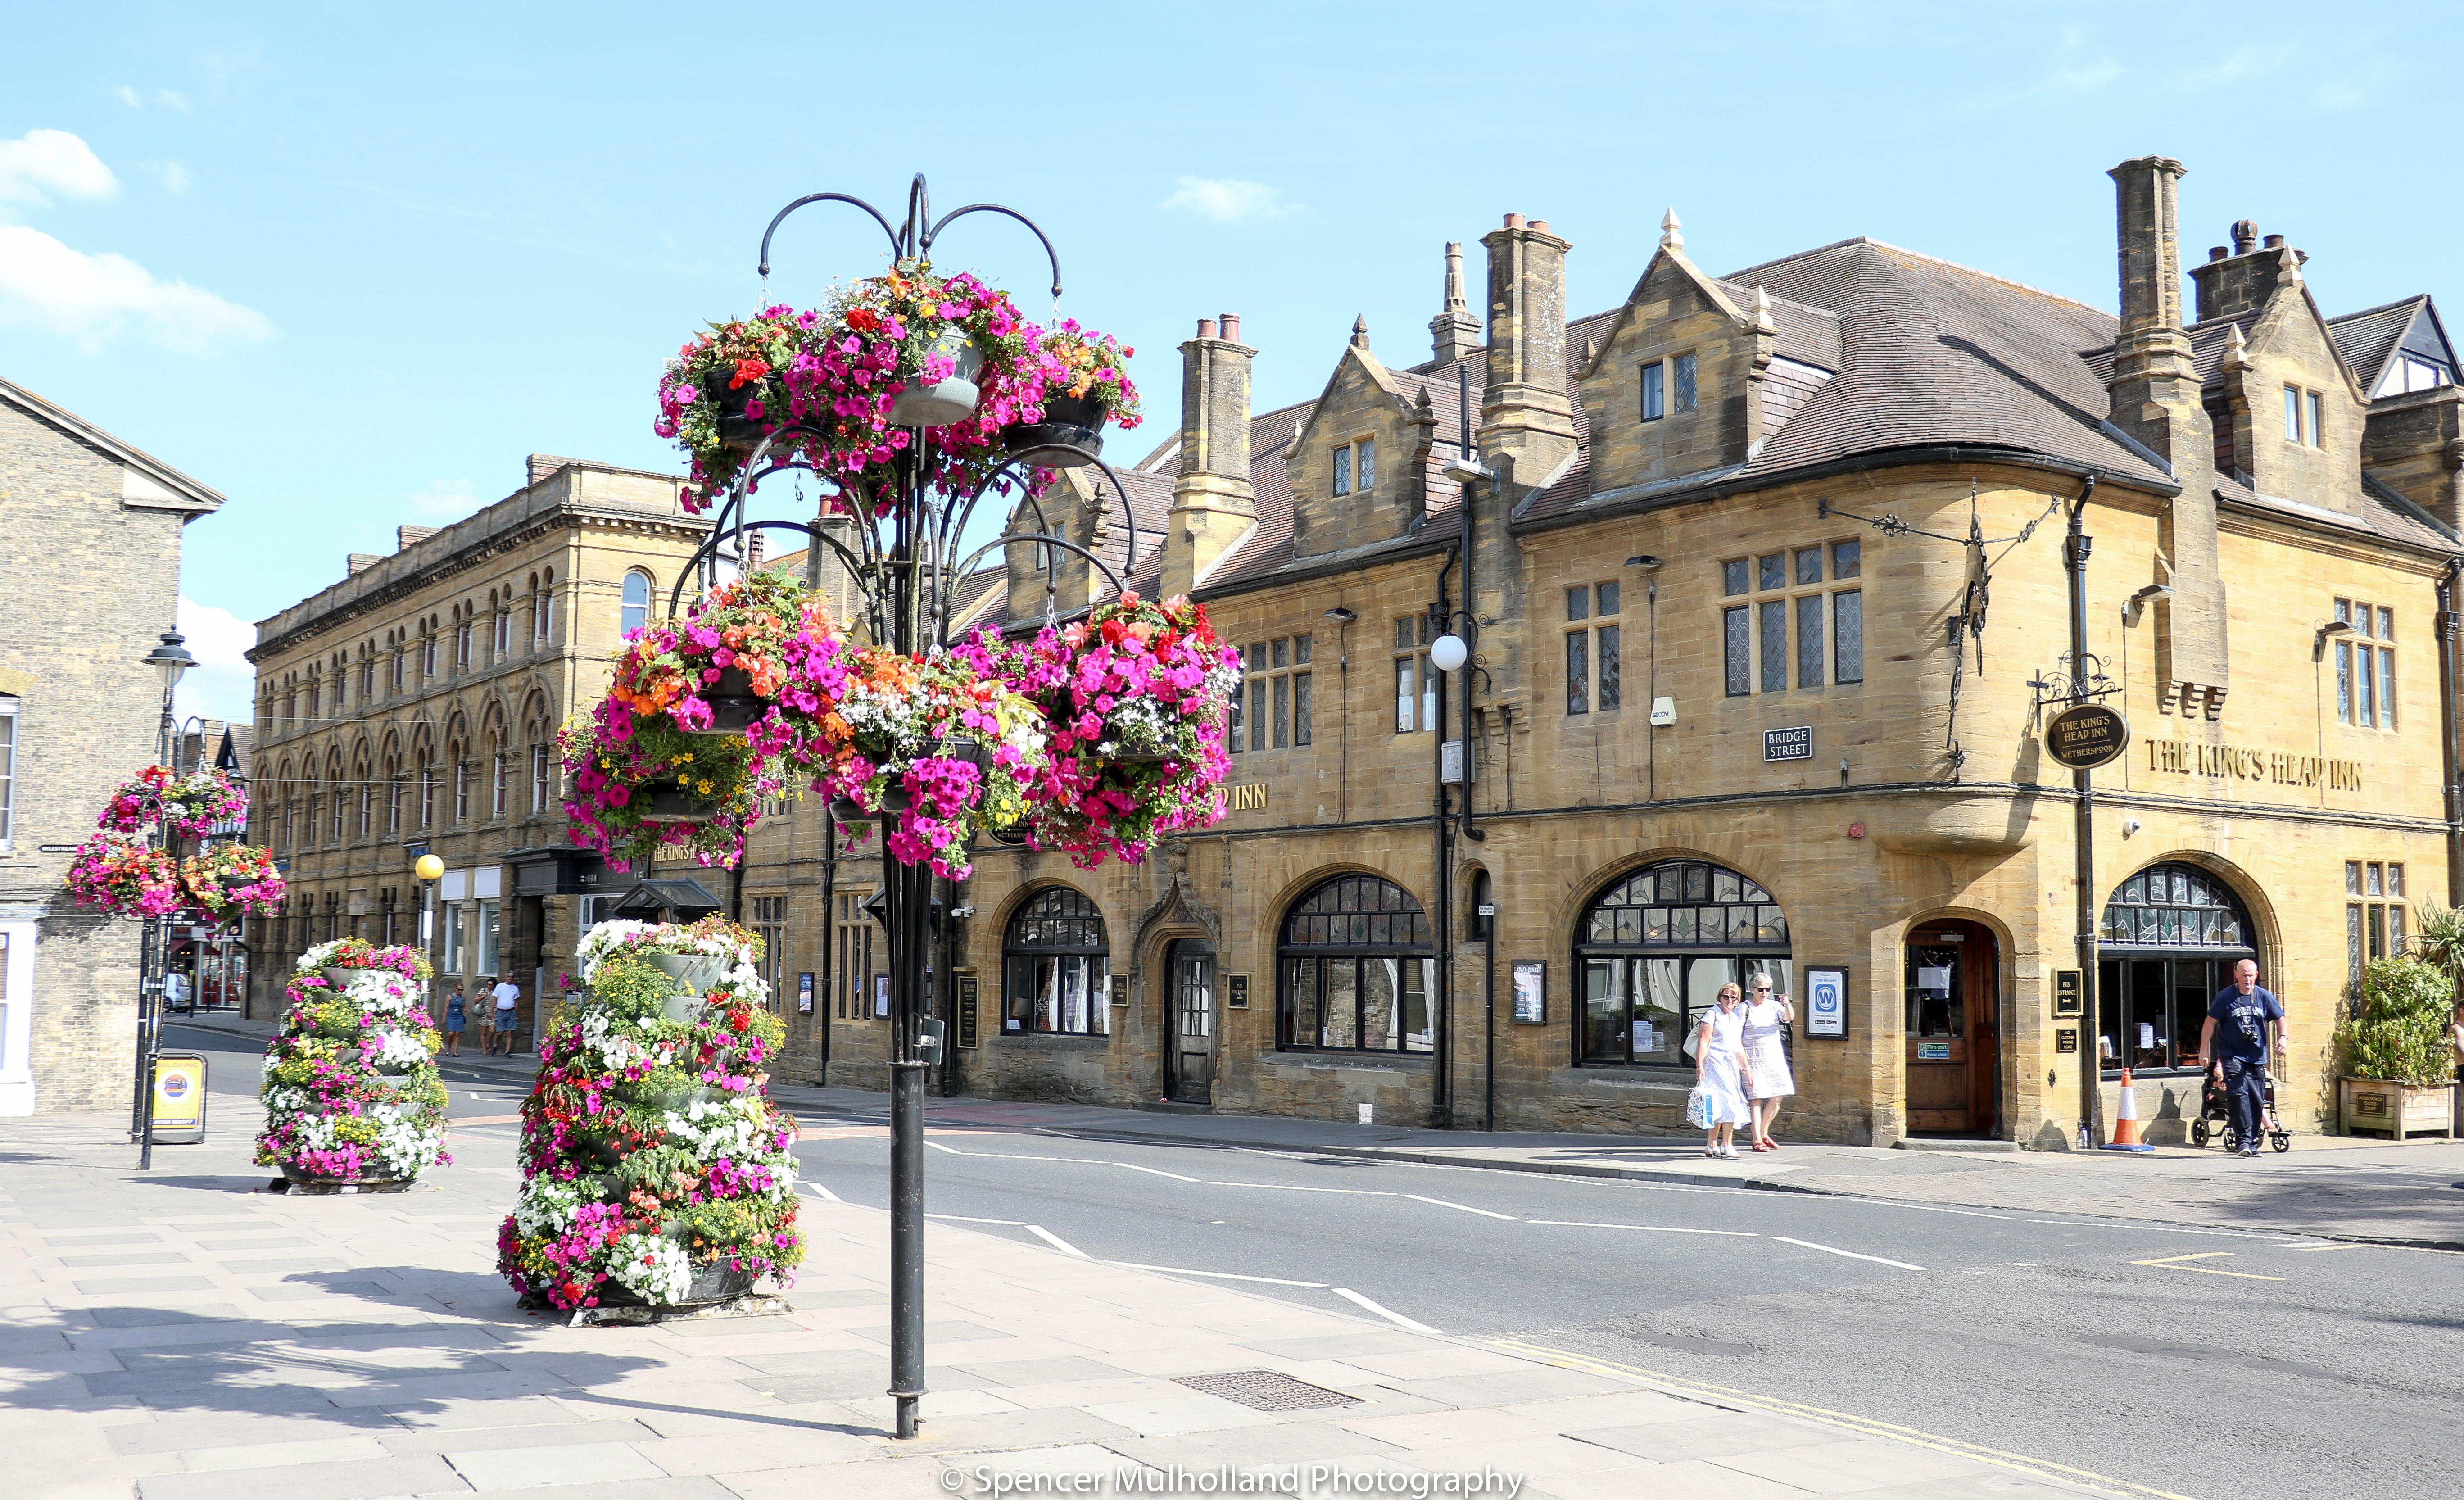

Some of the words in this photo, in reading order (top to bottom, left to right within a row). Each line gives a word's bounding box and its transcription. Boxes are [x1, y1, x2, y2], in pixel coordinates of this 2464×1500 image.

[2060, 721, 2080, 732] THE
[2081, 715, 2110, 729] KING'S
[1768, 730, 1807, 744] BRIDGE
[2064, 730, 2089, 742] HEAD
[2092, 726, 2108, 738] INN
[1770, 743, 1807, 757] STREET
[2061, 744, 2114, 759] WETHERSPOON
[2145, 738, 2192, 774] THE
[2198, 743, 2266, 781] KING'S
[2271, 752, 2327, 787] HEAD
[2329, 758, 2363, 791] INN
[1235, 784, 1266, 810] INN
[654, 846, 667, 862] THE
[667, 844, 689, 861] KING'S
[1819, 992, 1833, 1004] W
